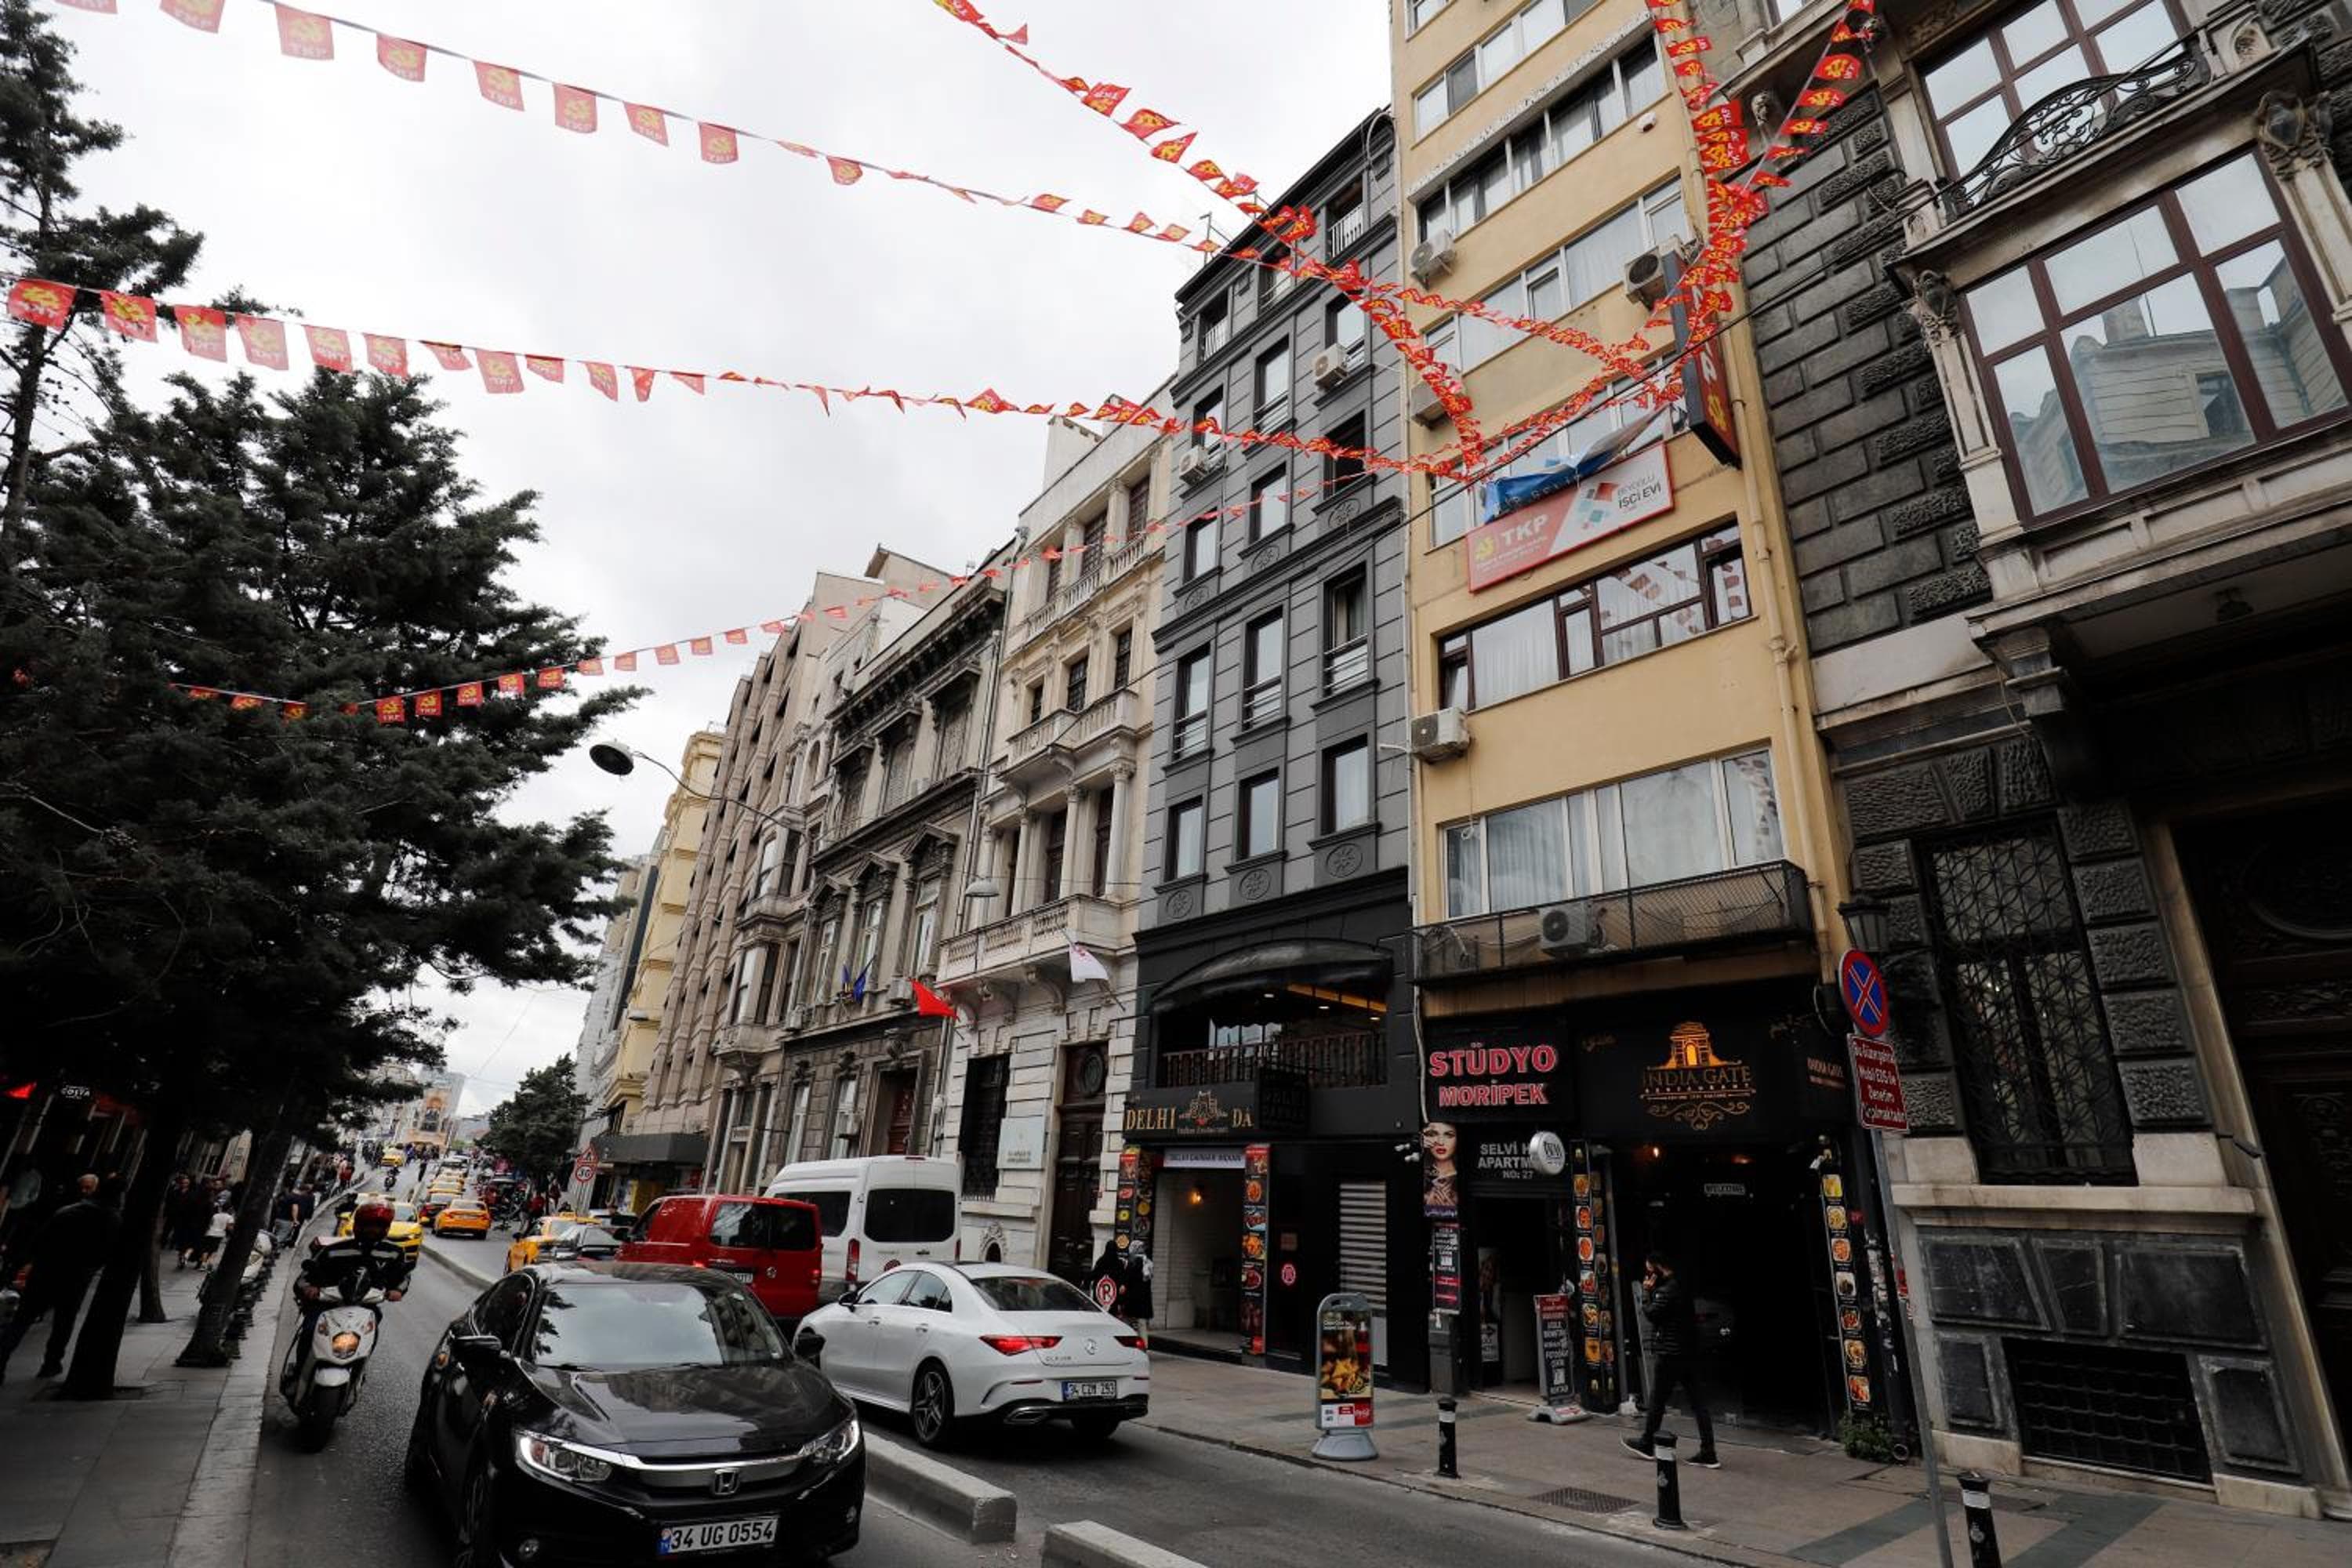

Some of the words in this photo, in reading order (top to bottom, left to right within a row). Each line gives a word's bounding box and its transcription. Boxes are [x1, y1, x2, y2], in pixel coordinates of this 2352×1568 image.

[1501, 514, 1549, 546] TKP
[1428, 1042, 1557, 1077] STÜDYO
[1643, 1069, 1697, 1087] INDIA
[1703, 1065, 1752, 1083] GATE
[1438, 1079, 1549, 1108] MORİPEK
[1127, 1107, 1176, 1130] DELHI
[1232, 1107, 1253, 1127] DA
[1477, 1156, 1531, 1169] APARTM
[671, 1528, 695, 1549] 34
[700, 1525, 724, 1547] UG
[728, 1521, 774, 1544] 0554
